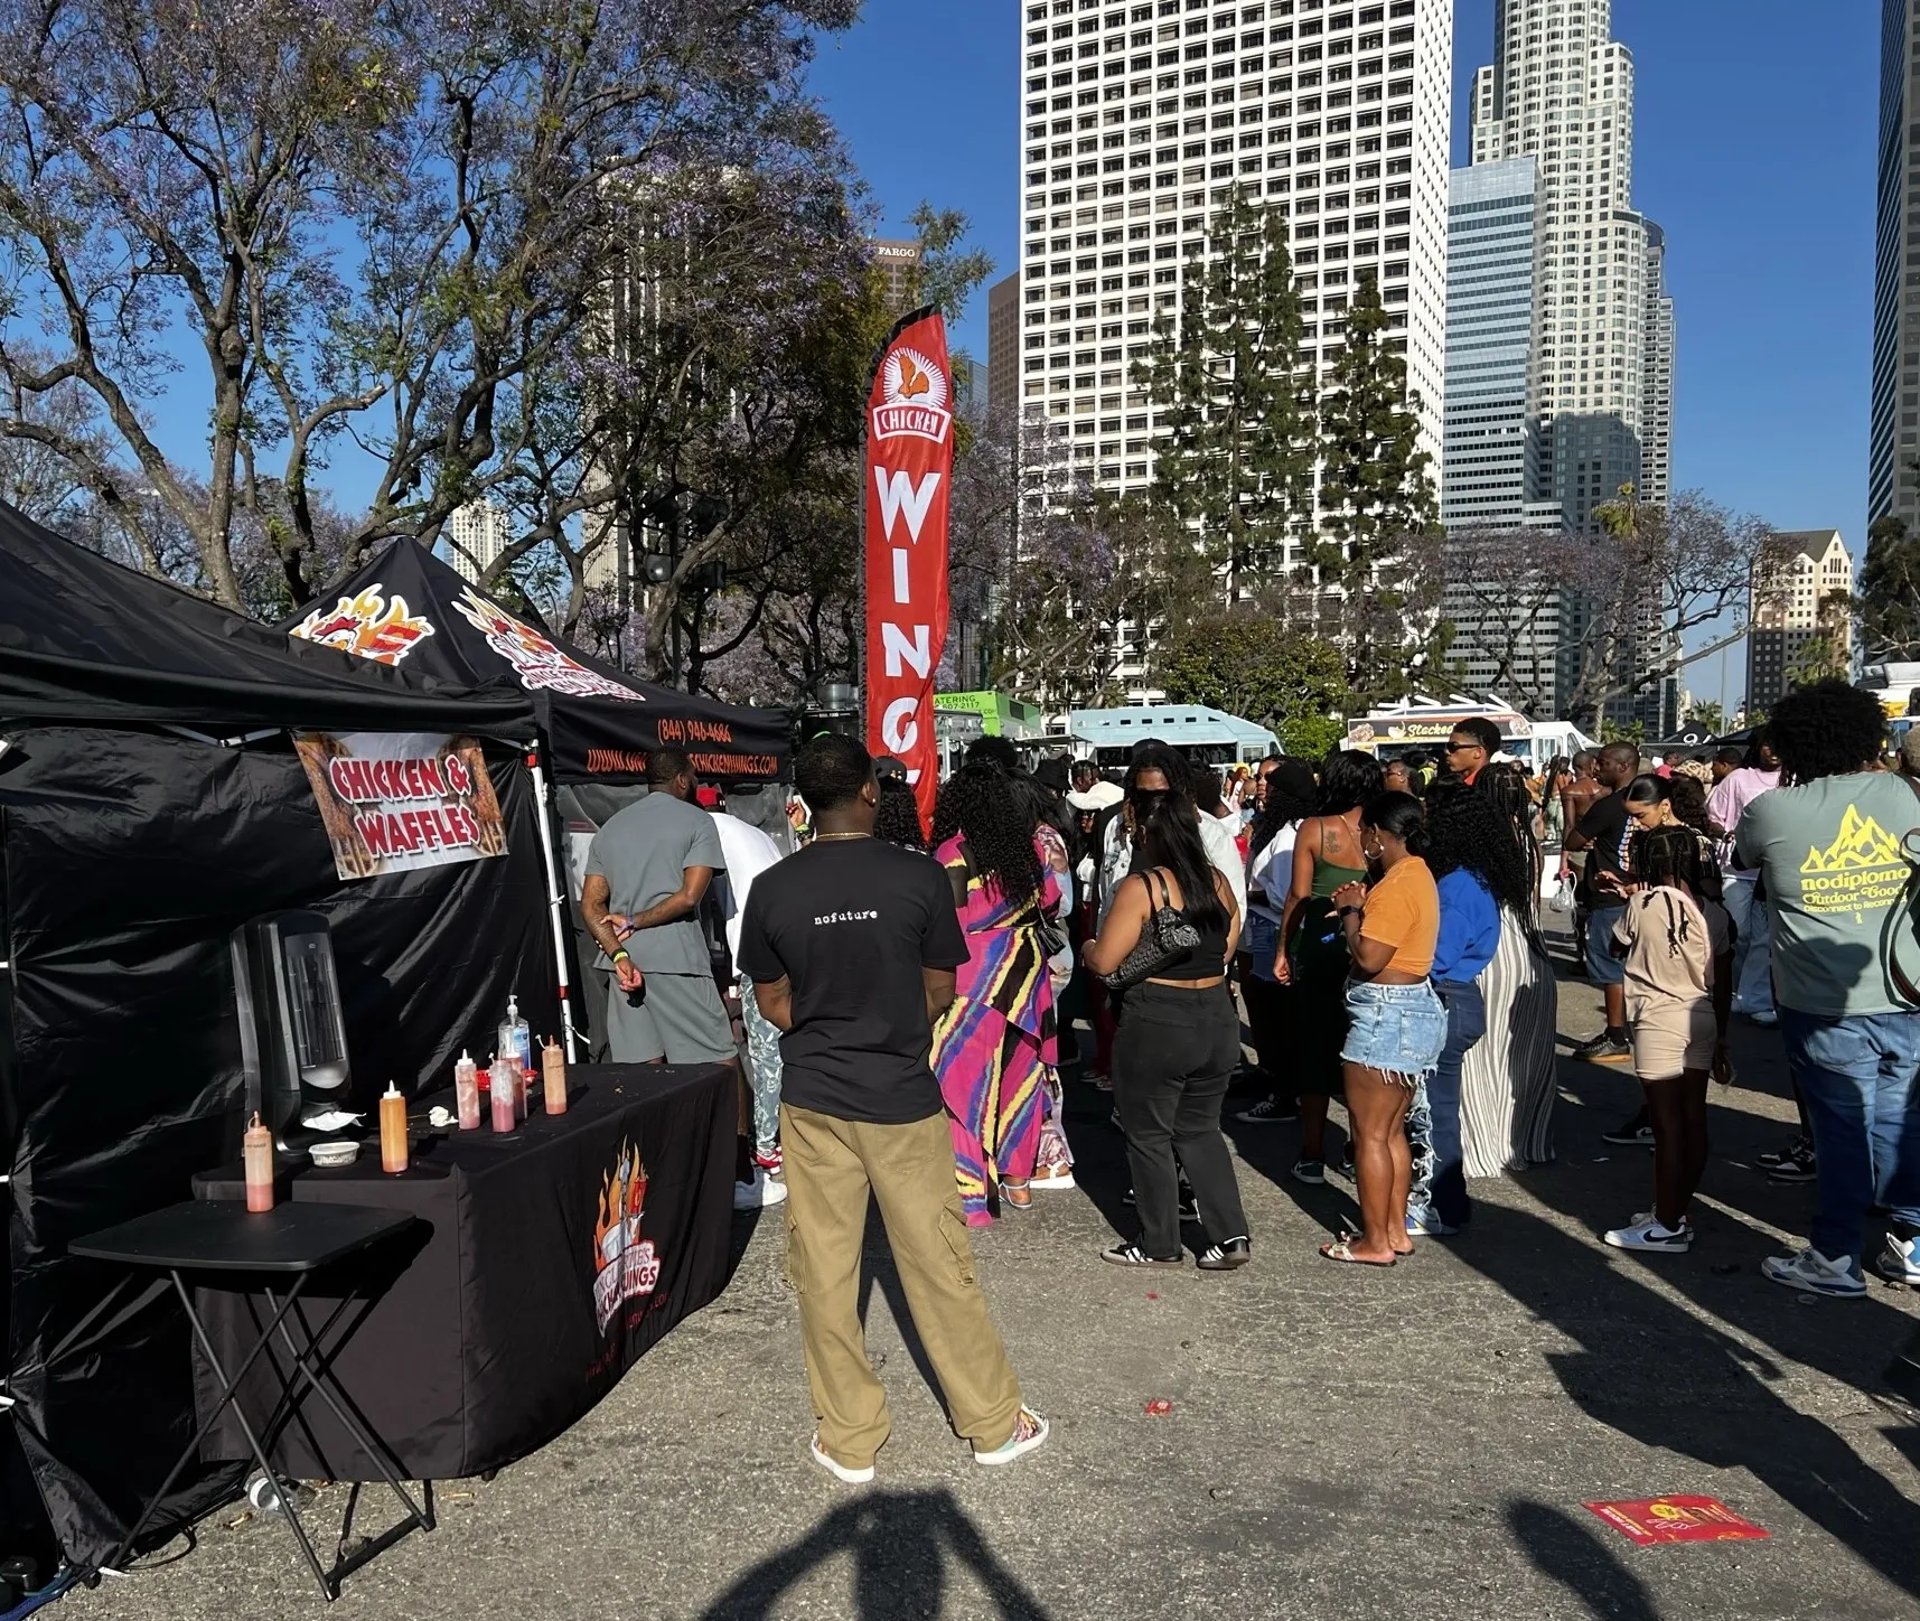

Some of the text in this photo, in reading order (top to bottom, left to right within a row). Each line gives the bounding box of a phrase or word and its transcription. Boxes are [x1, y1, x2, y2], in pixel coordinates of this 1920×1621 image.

[878, 247, 916, 257] FARGO
[881, 409, 939, 434] CHICKEN
[873, 466, 941, 784] WING
[935, 695, 976, 704] ATERING
[658, 719, 732, 746] (844) 946-4686
[329, 754, 472, 804] CHICKEN &
[354, 804, 480, 859] WAFFLES
[814, 910, 878, 925] nofuture
